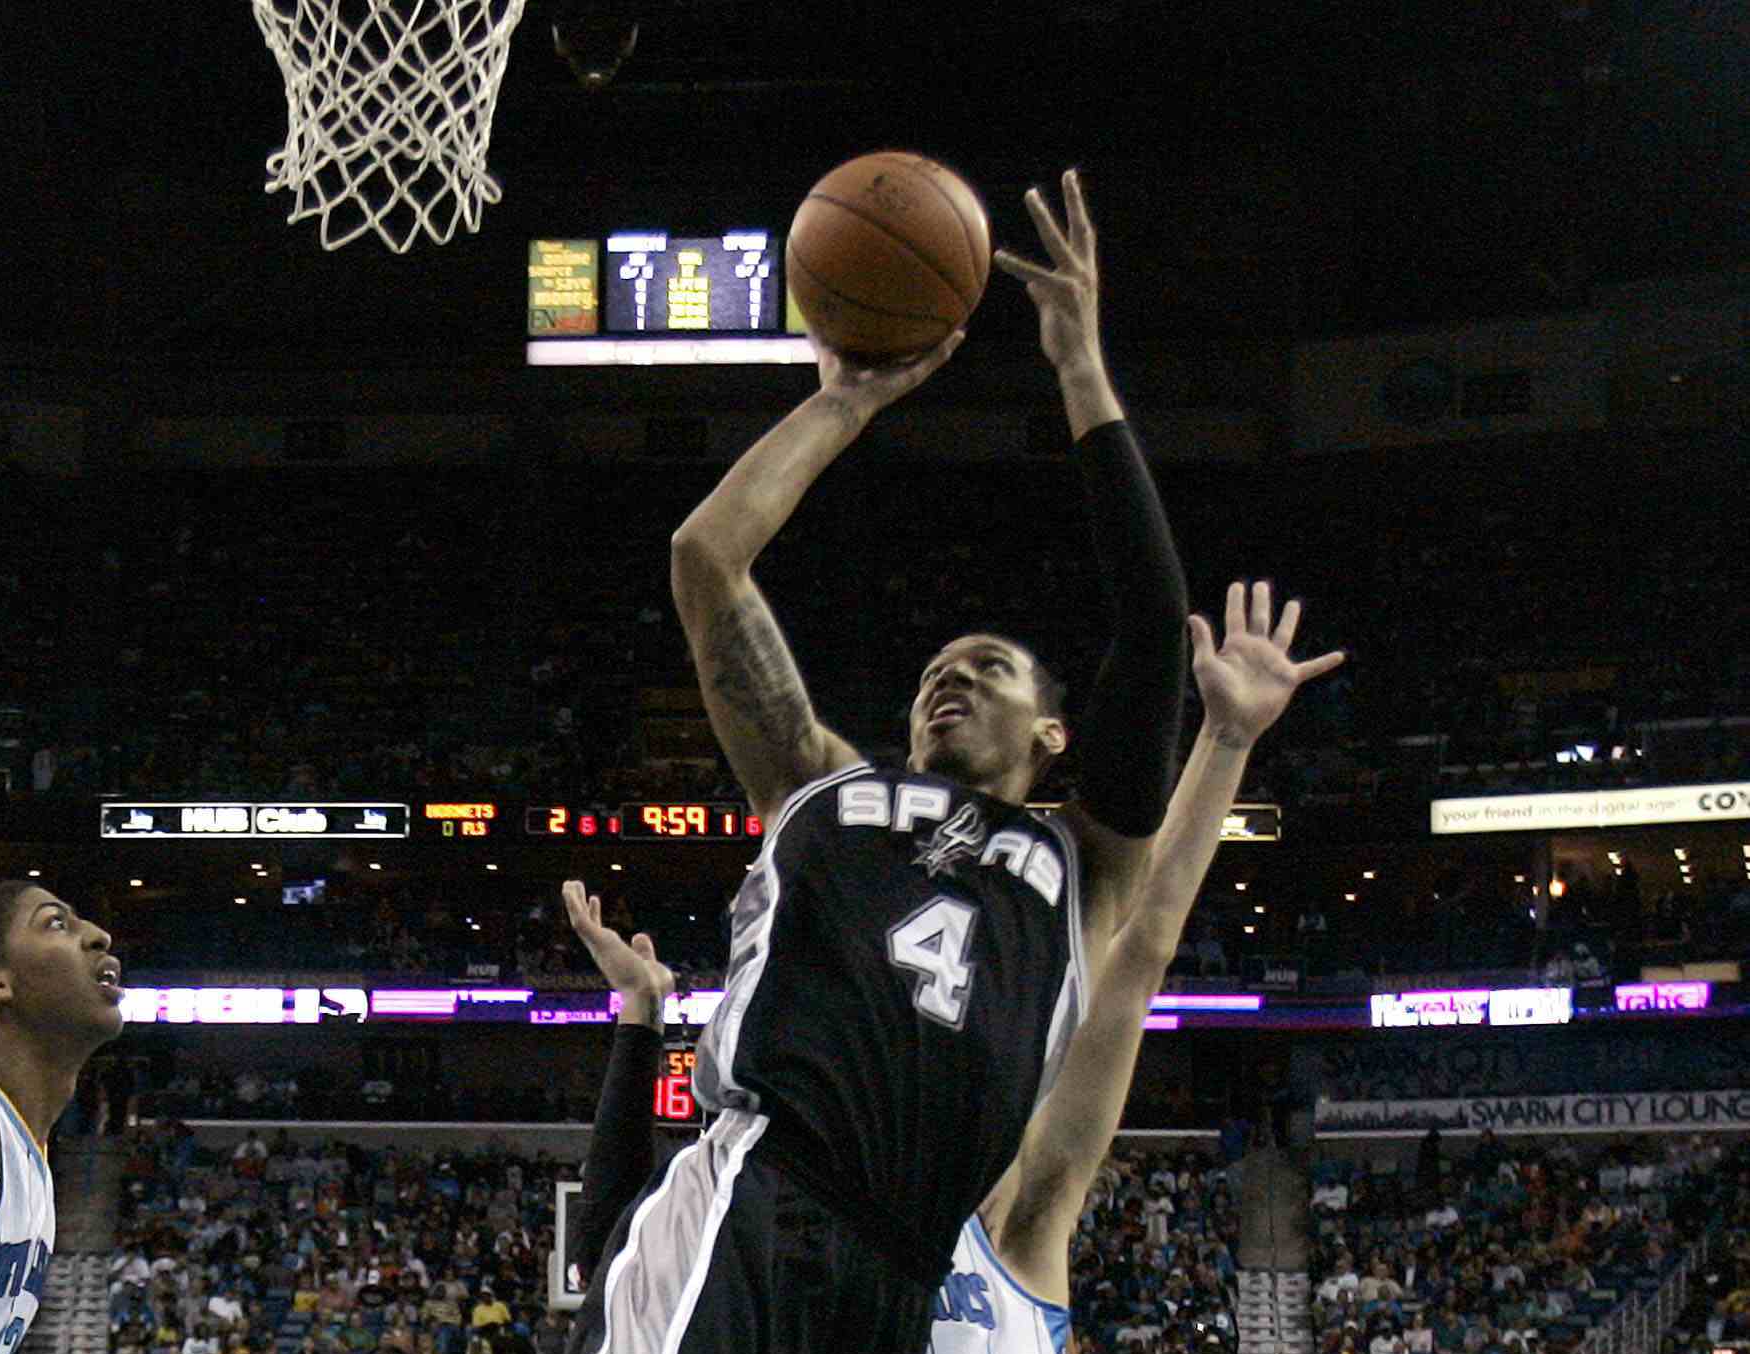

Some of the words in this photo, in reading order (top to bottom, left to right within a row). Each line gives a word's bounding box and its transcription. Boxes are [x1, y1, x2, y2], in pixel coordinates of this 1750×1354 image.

[181, 807, 249, 832] HUB
[256, 808, 327, 833] Club
[550, 808, 566, 833] 2
[643, 806, 706, 835] 9:59
[837, 779, 1063, 907] SPURS
[885, 895, 981, 1032] 4
[653, 1076, 694, 1119] 16
[1471, 1100, 1565, 1127] SWARM
[1572, 1097, 1644, 1125] CITY
